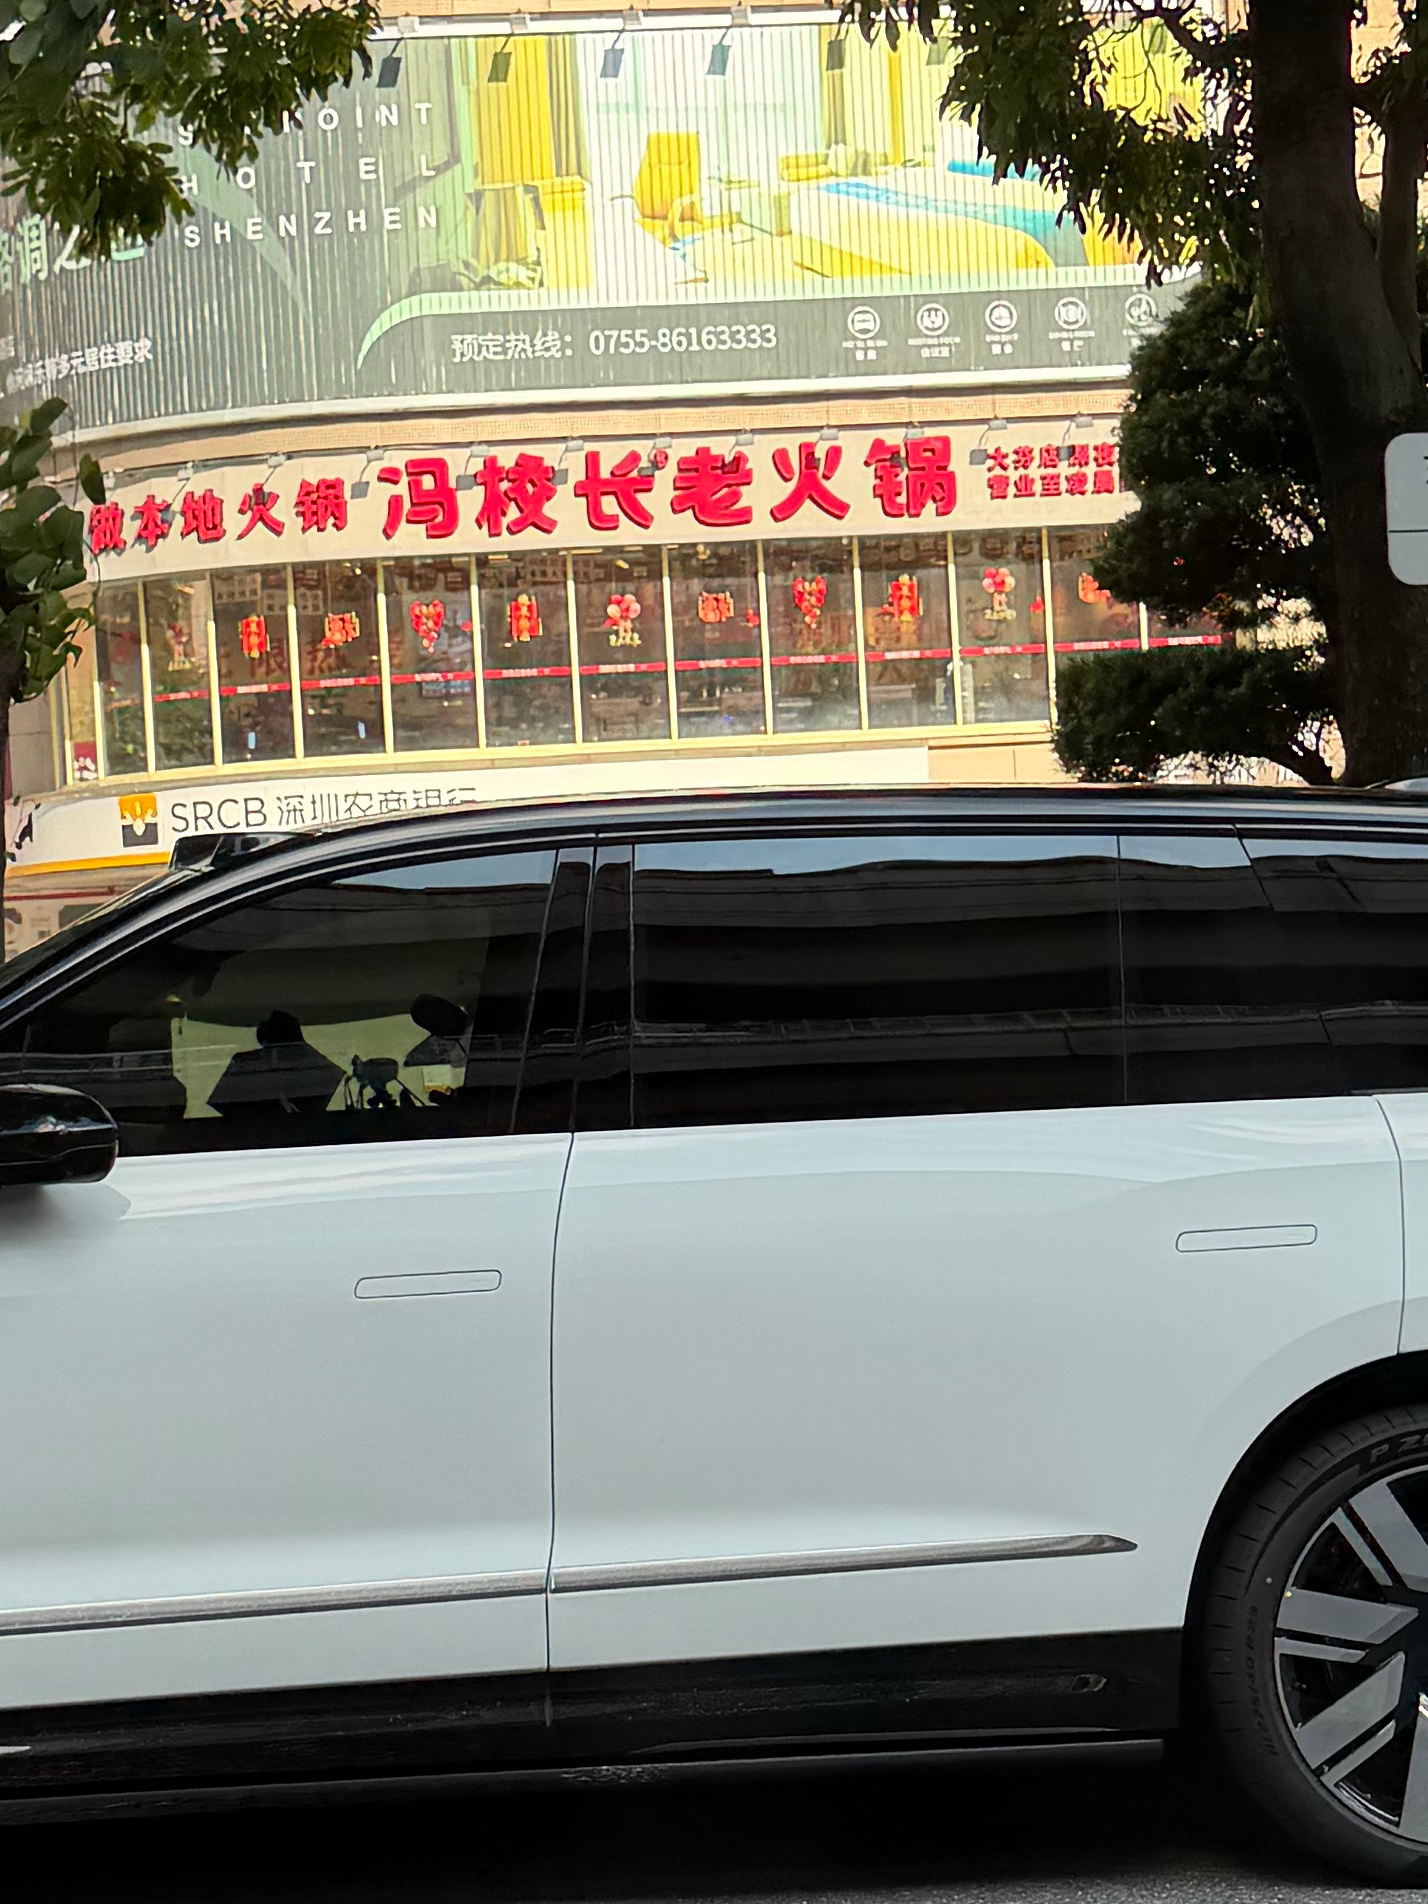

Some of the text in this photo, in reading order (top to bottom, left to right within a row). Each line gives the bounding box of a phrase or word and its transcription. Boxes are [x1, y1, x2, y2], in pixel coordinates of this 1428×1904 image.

[184, 204, 438, 248] SHENZHEN
[589, 324, 777, 355] 0755-86163333
[377, 435, 958, 540] 冯校长老火锅
[171, 796, 267, 833] SRCB
